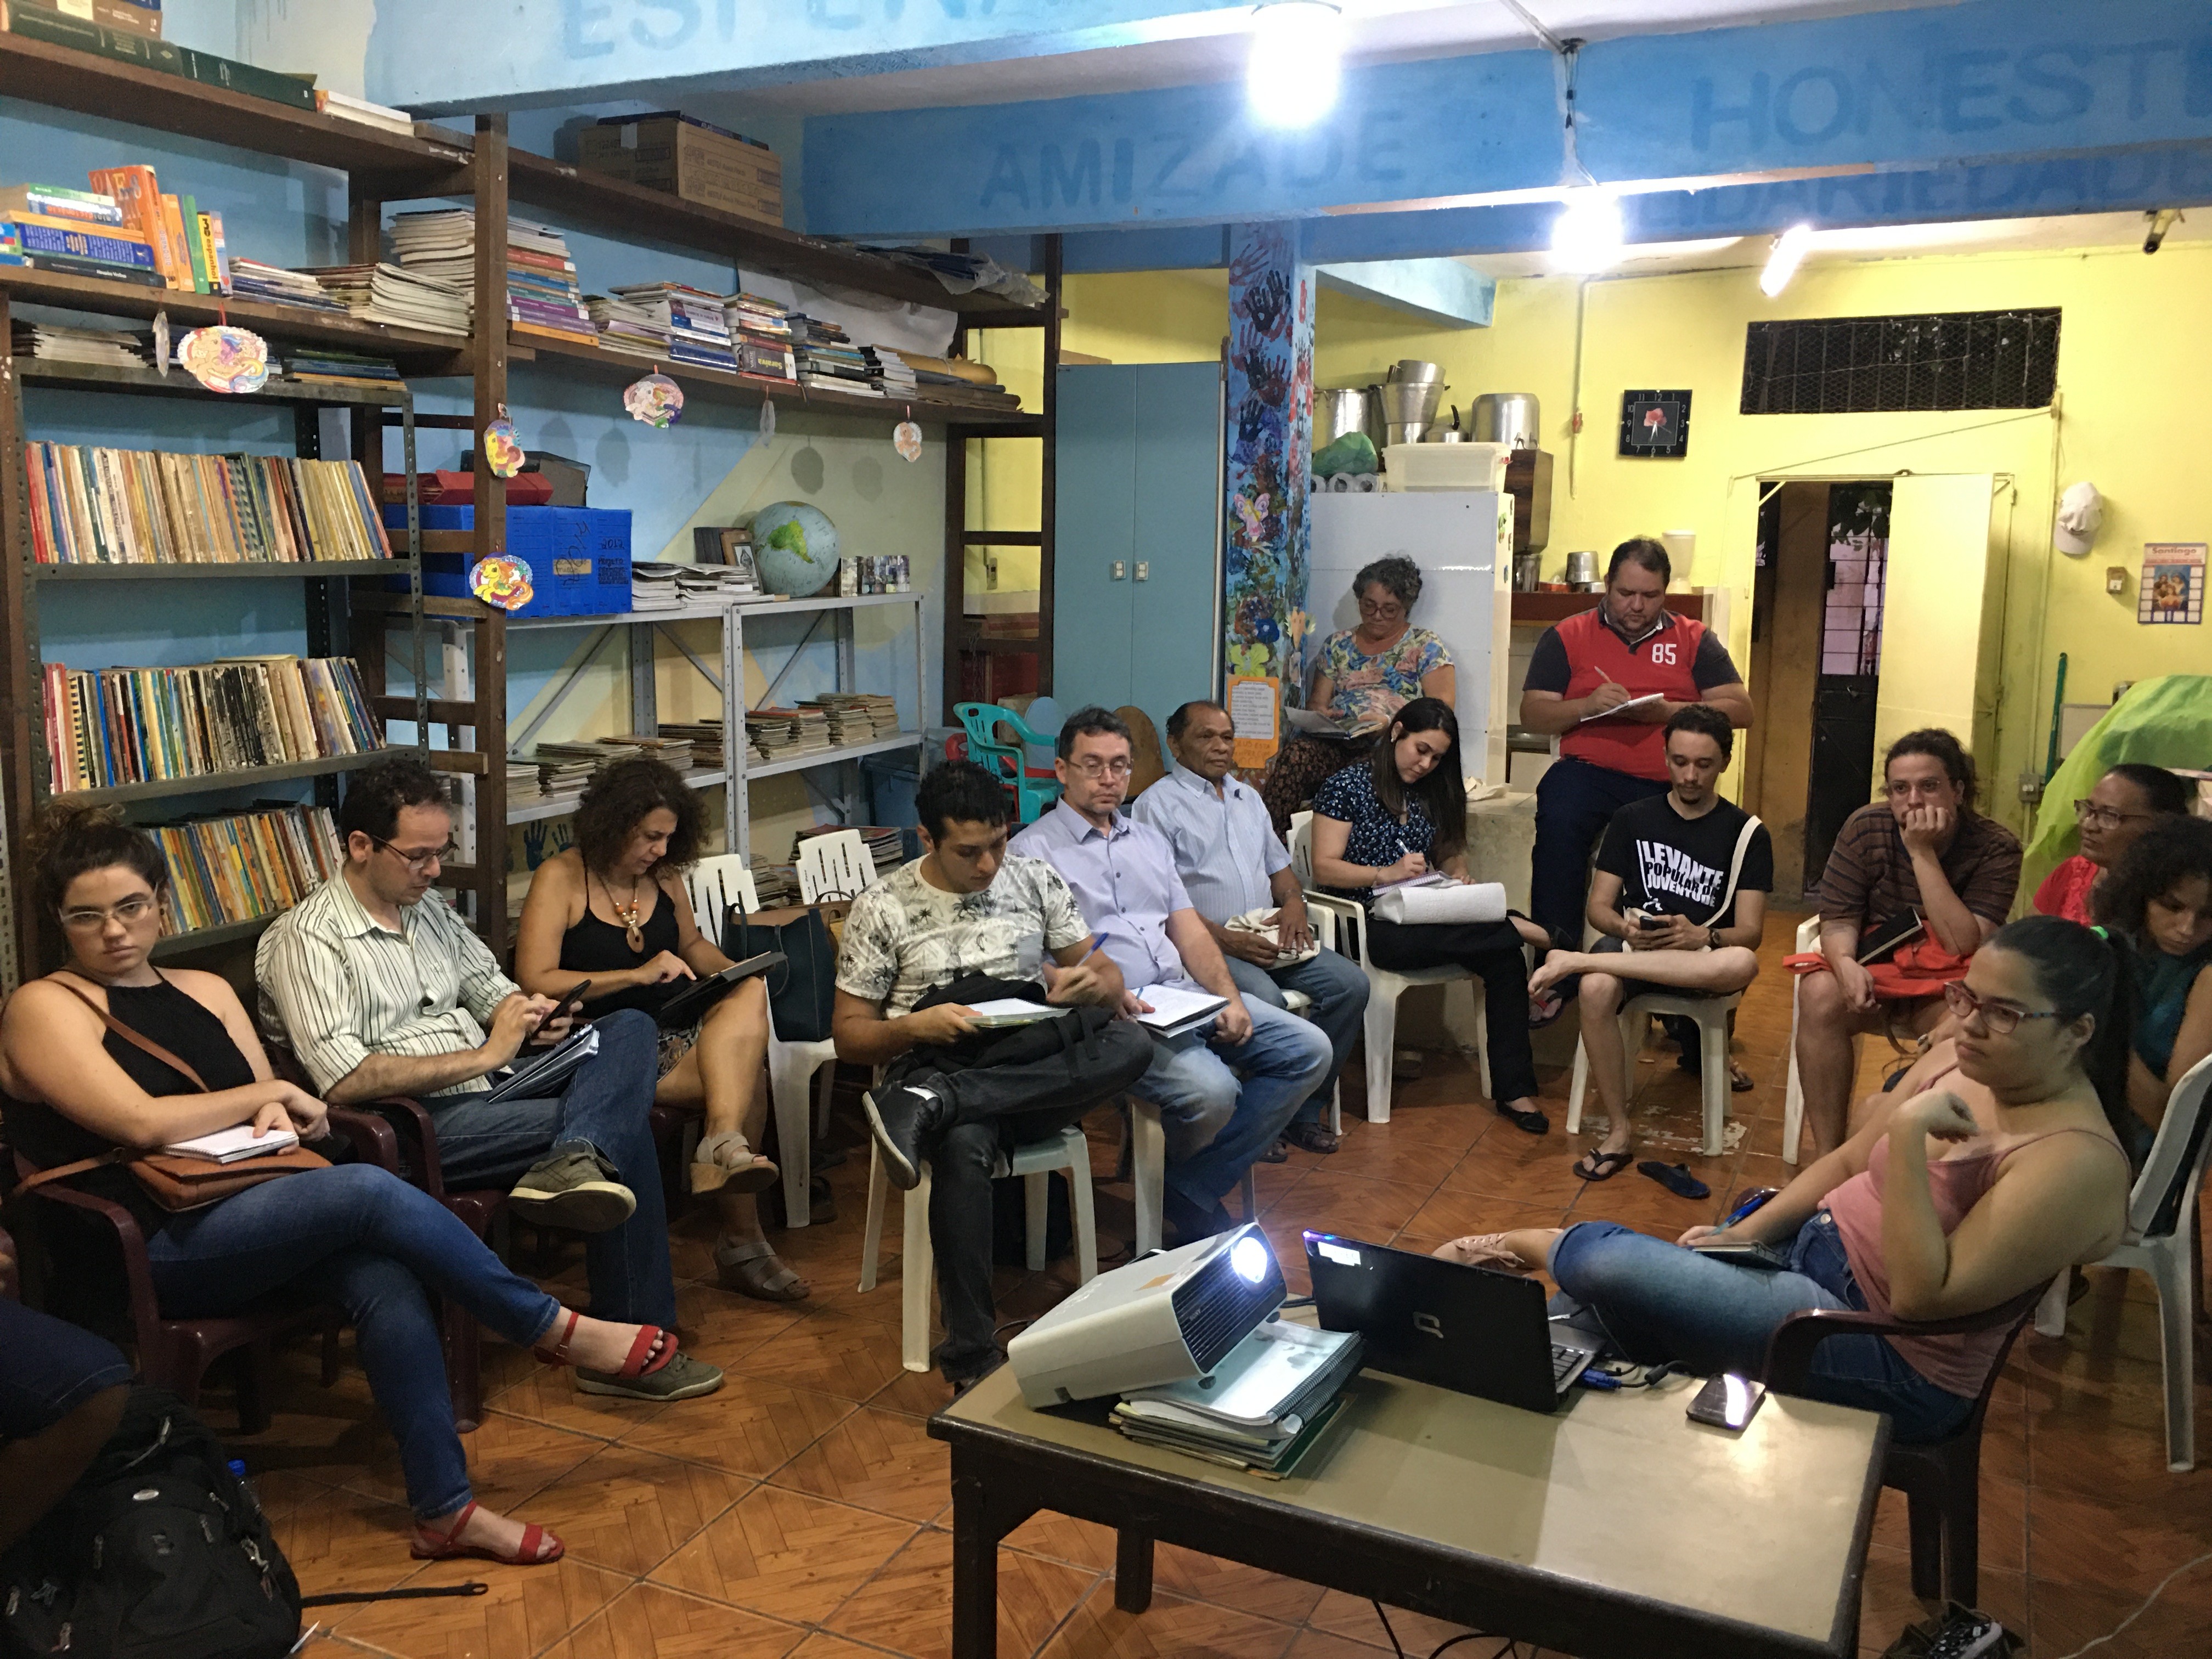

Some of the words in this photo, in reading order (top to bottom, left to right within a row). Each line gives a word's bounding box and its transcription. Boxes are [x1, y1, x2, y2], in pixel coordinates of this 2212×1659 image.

[979, 109, 1408, 210] AMIZADE
[206, 238, 218, 279] espanhol
[758, 358, 783, 370] Saraiva
[1639, 393, 1645, 401] 11
[1654, 393, 1663, 401] 12
[1671, 393, 1675, 401] 1
[1627, 404, 1635, 413] 10
[1681, 404, 1686, 413] 2
[1627, 420, 1632, 428] 9
[1680, 420, 1685, 428] 3
[1625, 434, 1630, 443] 8
[1679, 434, 1684, 443] 4
[1635, 445, 1640, 454] 7
[1651, 445, 1656, 454] 6
[1666, 445, 1671, 454] 5
[2152, 546, 2197, 556] Santiago
[1651, 642, 1678, 666] 85
[1641, 840, 1724, 890] LEVANTE
[1647, 861, 1700, 893] POPULAR
[1647, 873, 1716, 908] JUVENTUDE
